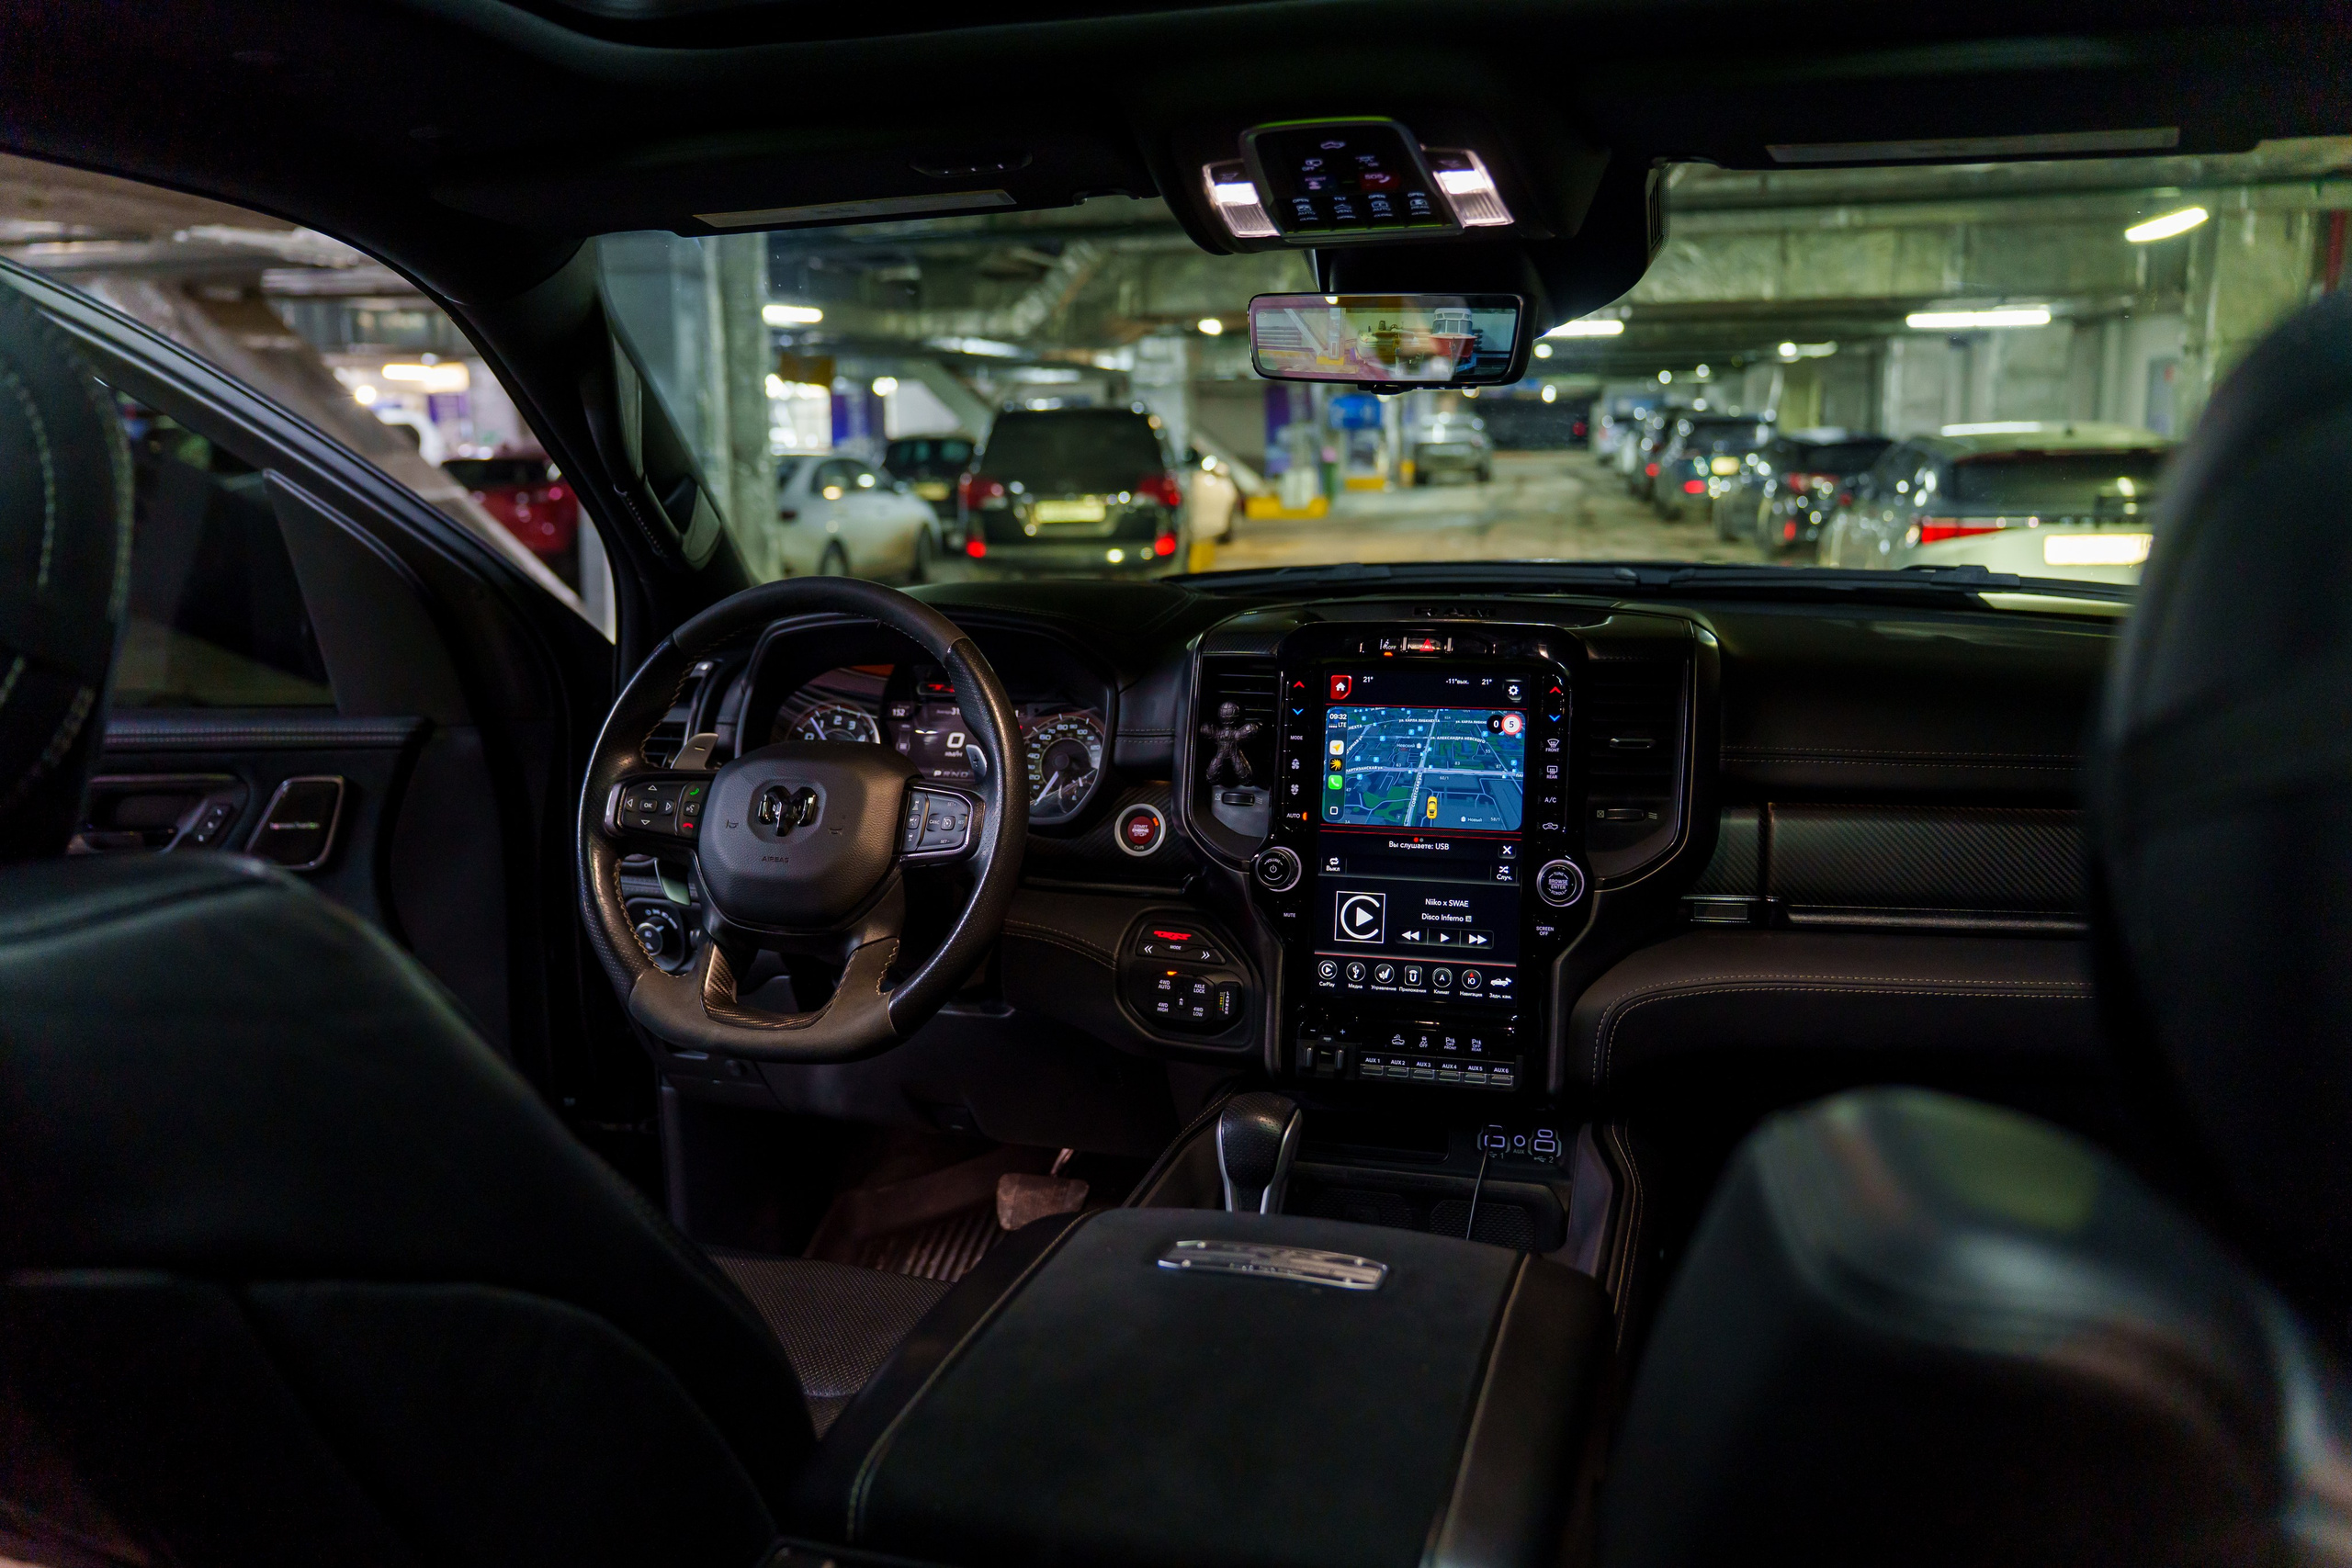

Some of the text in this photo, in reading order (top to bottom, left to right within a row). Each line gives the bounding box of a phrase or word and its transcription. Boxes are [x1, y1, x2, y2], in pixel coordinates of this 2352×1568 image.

[892, 708, 905, 716] 152
[820, 720, 824, 728] 1
[833, 716, 842, 725] 2
[848, 720, 856, 730] 3
[946, 732, 966, 749] 0
[1448, 899, 1469, 908] SWAE
[1421, 912, 1440, 920] Disco
[1441, 914, 1464, 922] Inferno
[1548, 1156, 1554, 1164] 2
